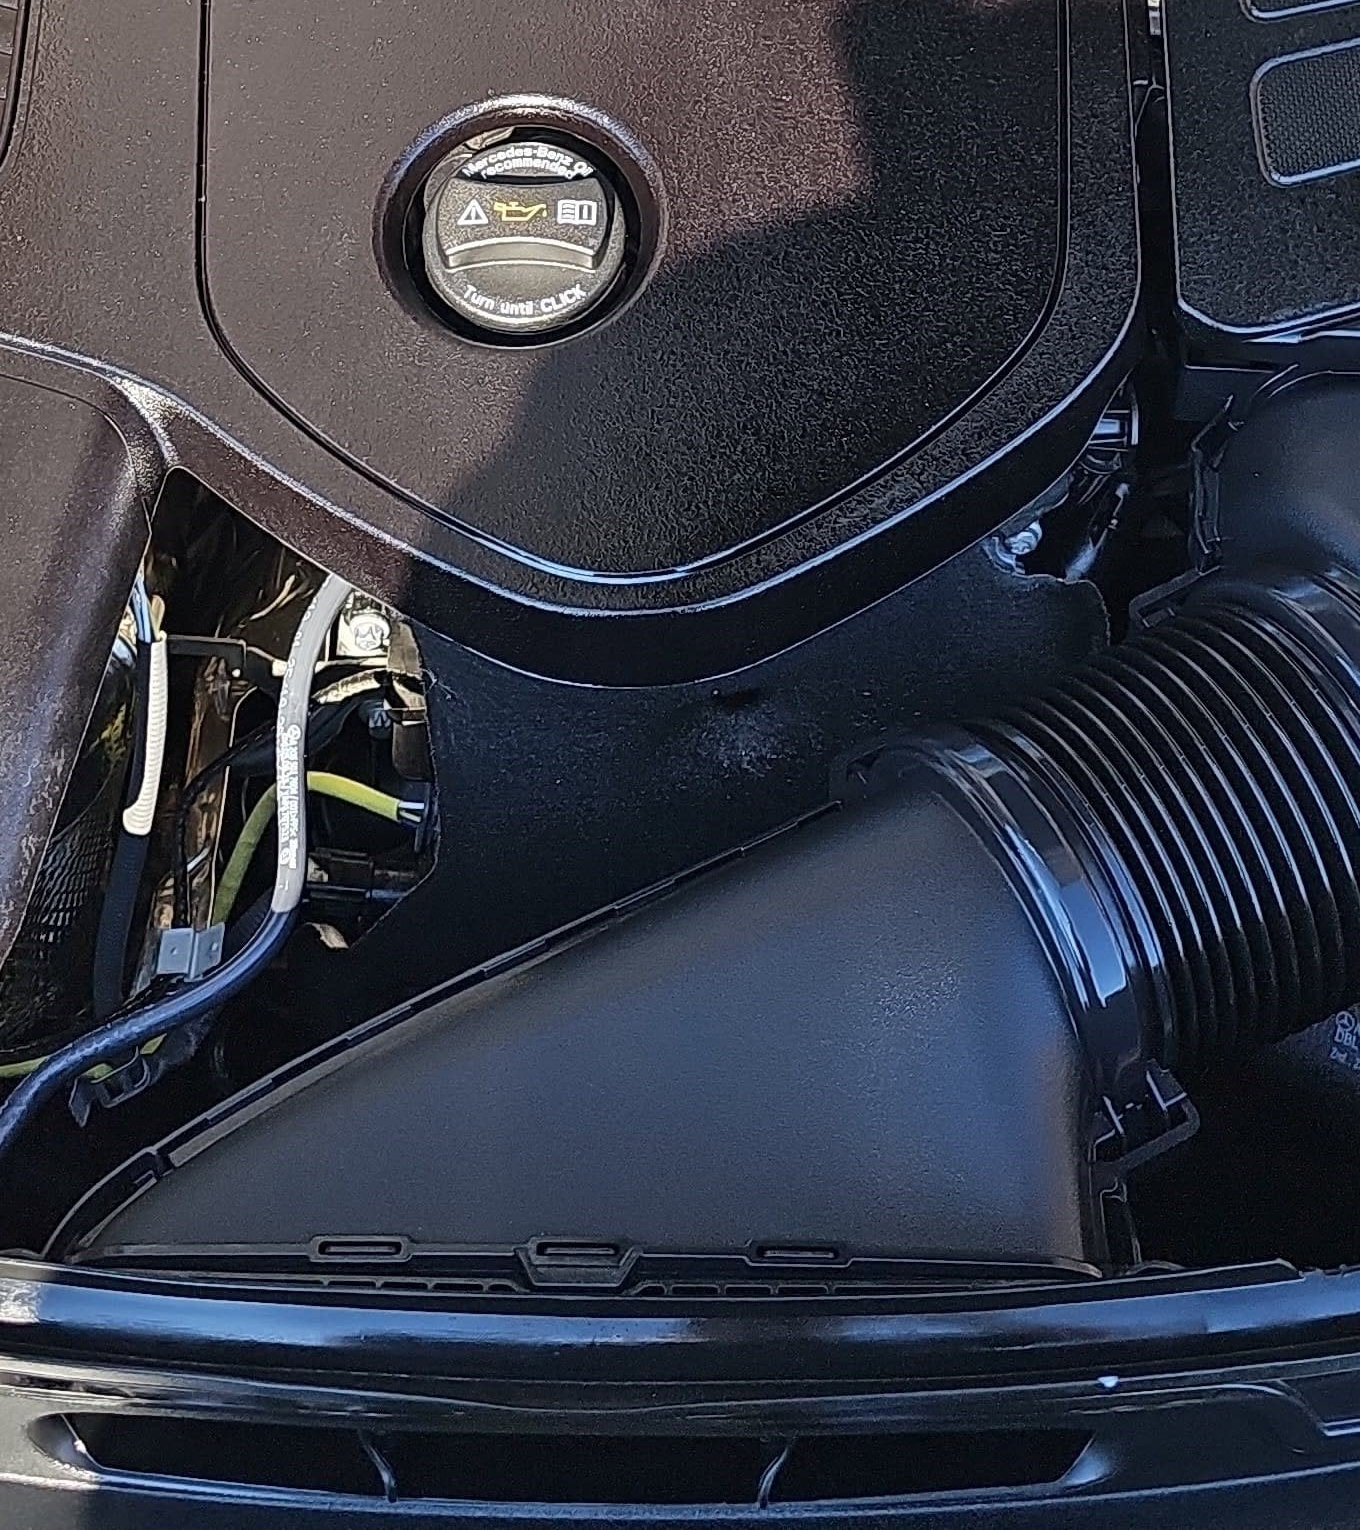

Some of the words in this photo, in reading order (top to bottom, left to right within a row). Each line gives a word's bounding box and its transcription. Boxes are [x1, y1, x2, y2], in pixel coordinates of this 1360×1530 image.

[461, 146, 574, 177] Mercedes-Benz
[573, 161, 594, 178] Oil
[480, 157, 577, 179] recommended
[463, 284, 495, 311] Turn
[500, 301, 534, 315] until
[539, 284, 588, 313] CLICK
